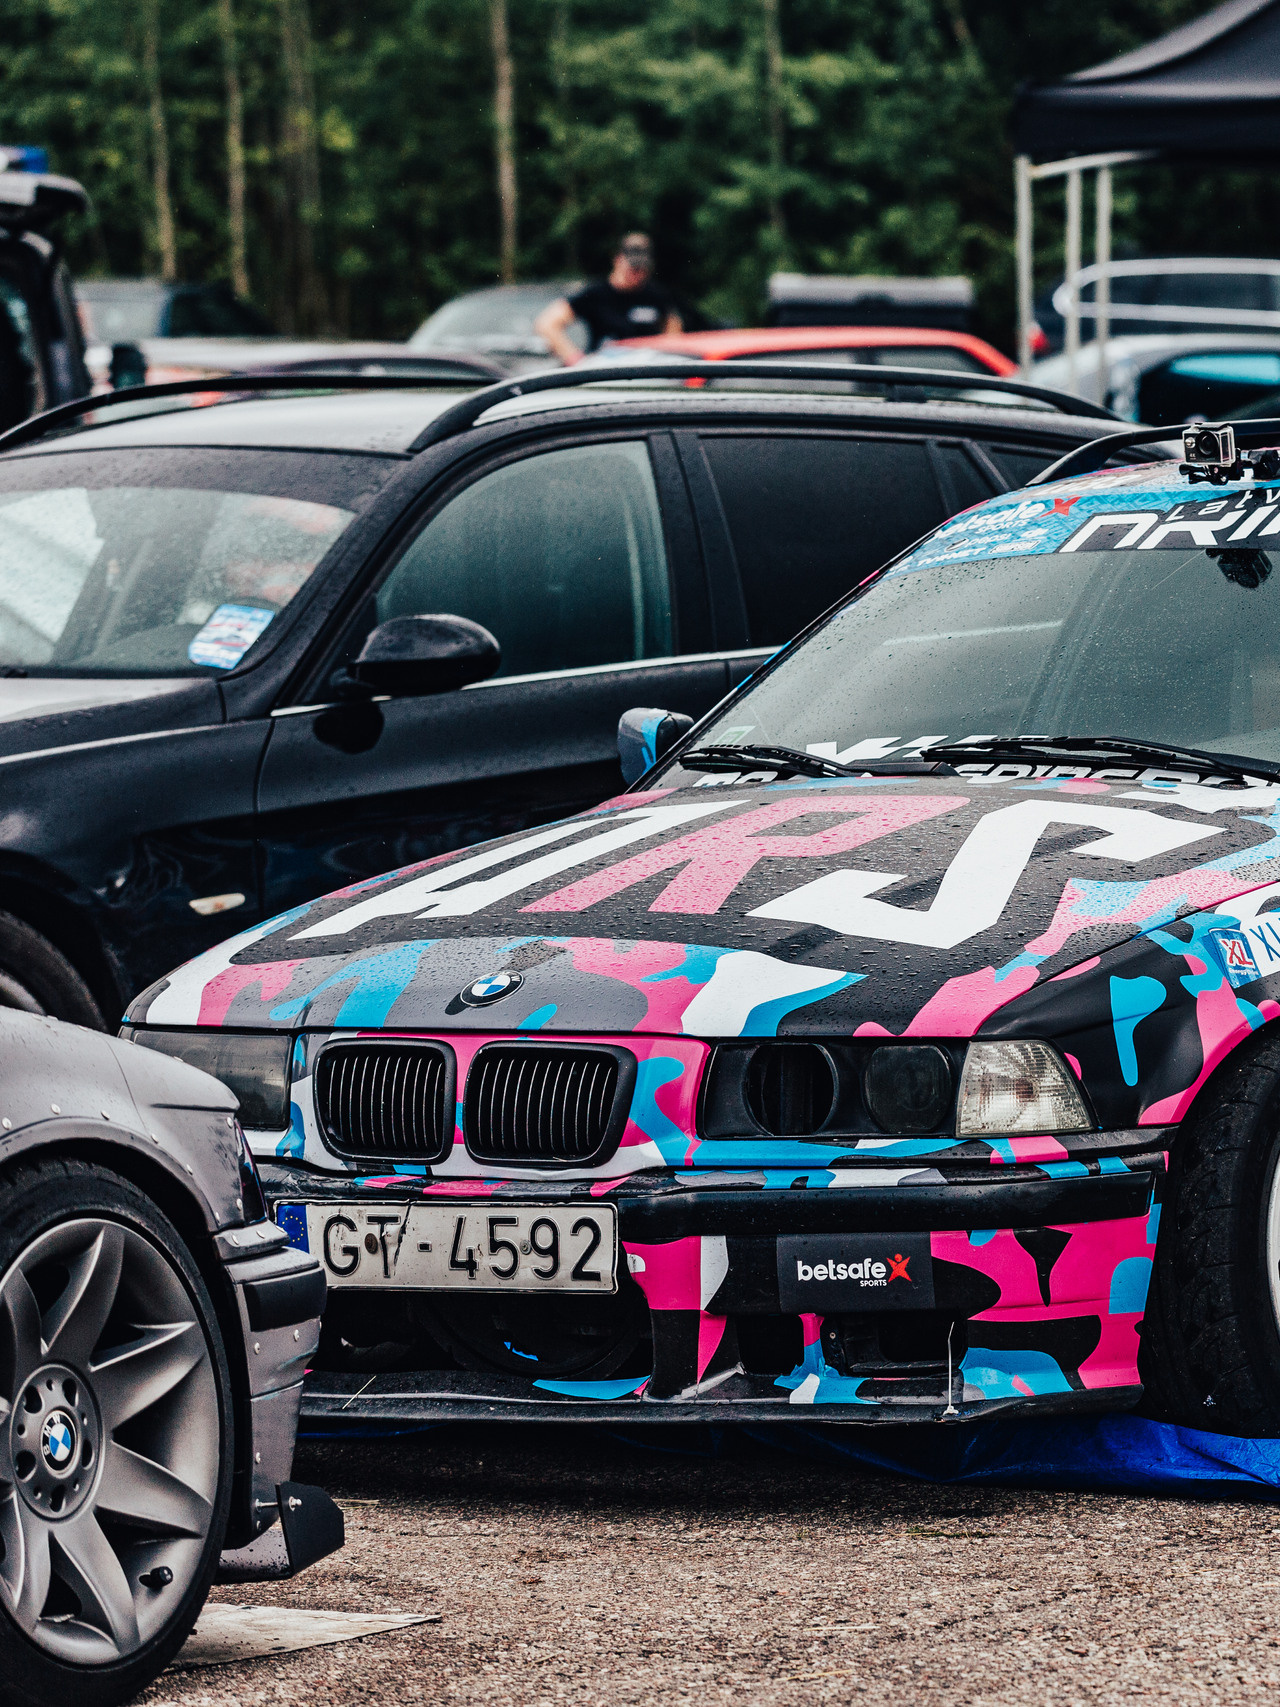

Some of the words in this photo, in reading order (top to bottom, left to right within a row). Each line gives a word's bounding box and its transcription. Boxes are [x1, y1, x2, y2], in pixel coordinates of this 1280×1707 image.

[1219, 938, 1255, 968] XL
[323, 1213, 603, 1282] GT-4592
[796, 1257, 887, 1281] betsafe
[859, 1279, 888, 1287] SPORTS
